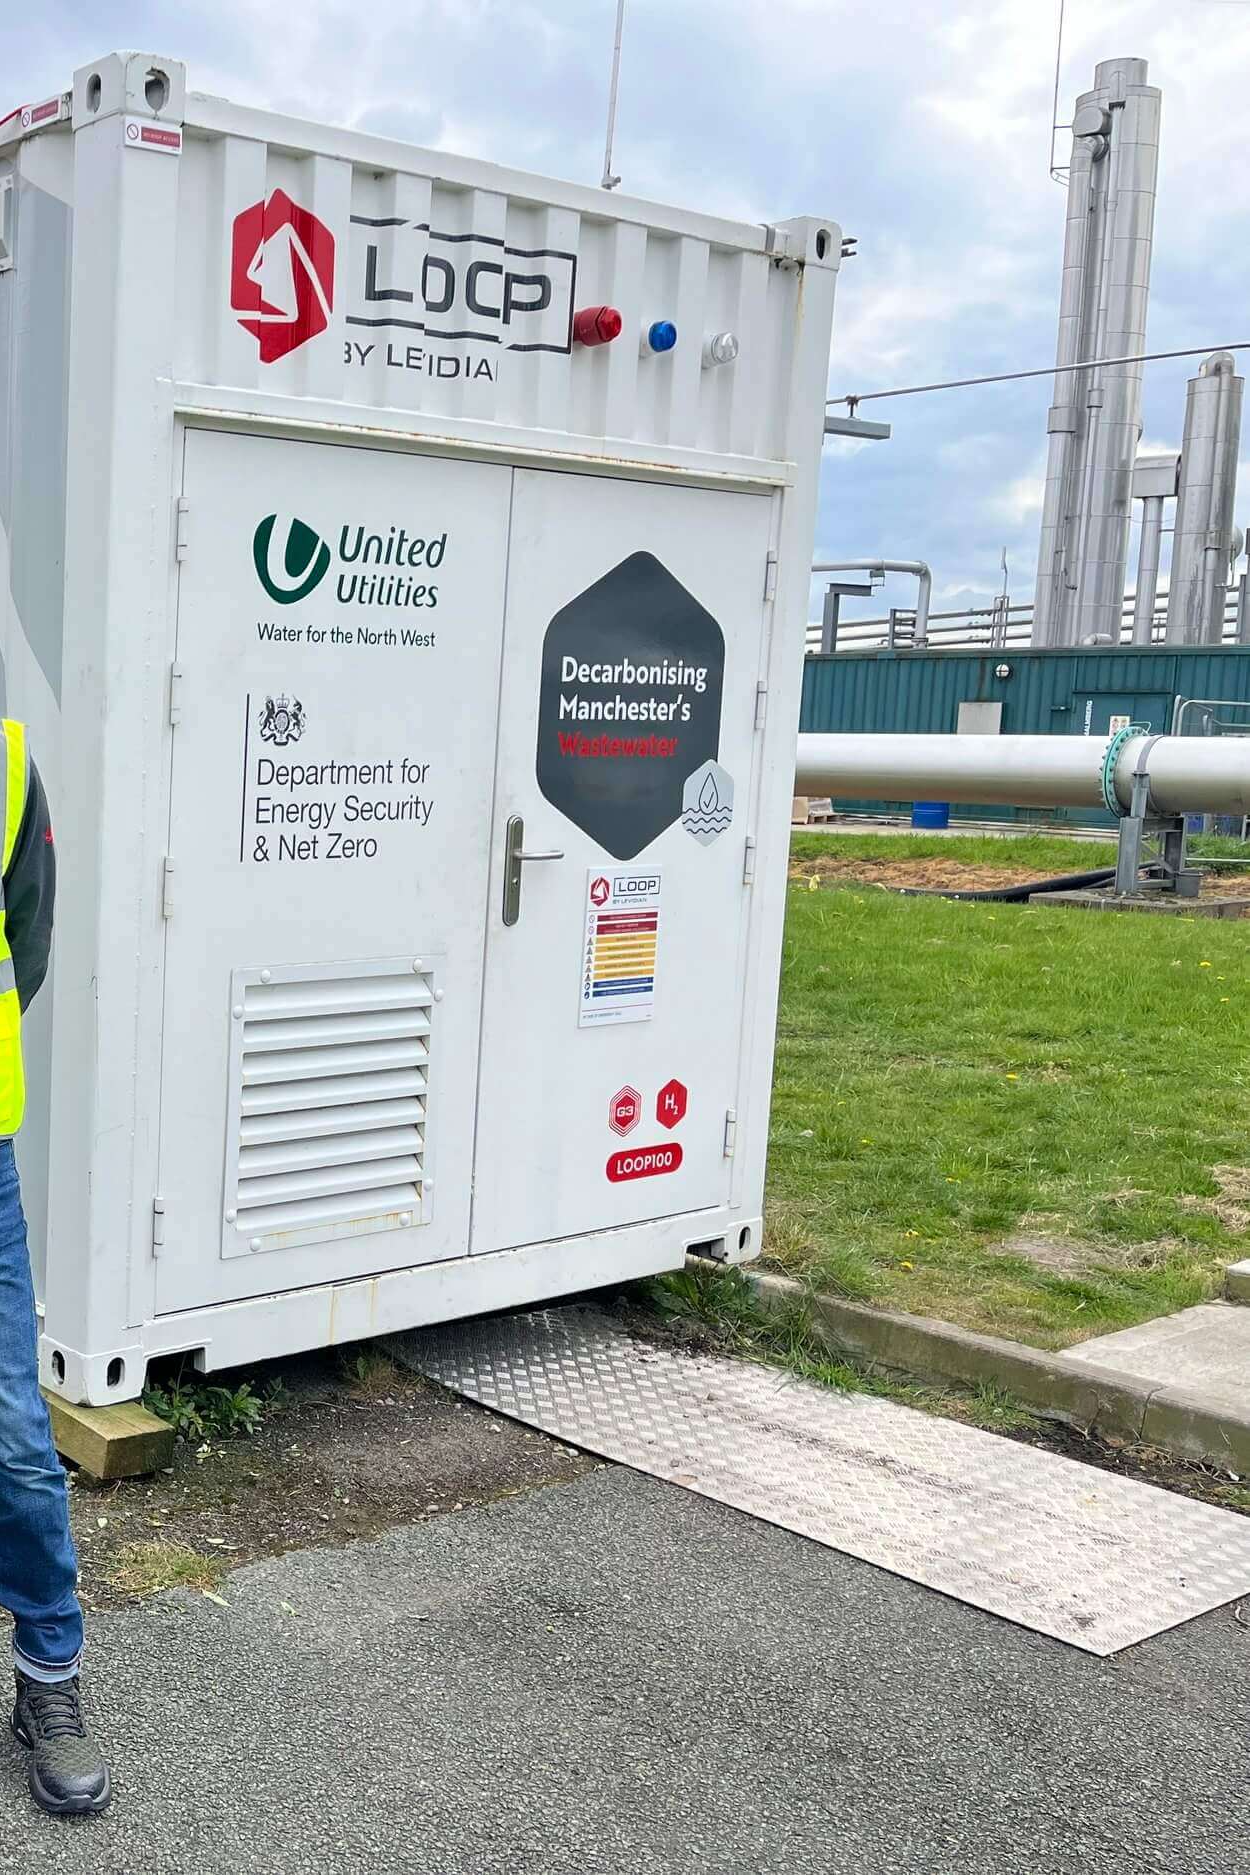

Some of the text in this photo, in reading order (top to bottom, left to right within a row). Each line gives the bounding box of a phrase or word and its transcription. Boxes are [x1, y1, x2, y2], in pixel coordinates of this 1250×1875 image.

[339, 525, 448, 568] United
[337, 574, 439, 608] Utilities
[257, 622, 436, 647] Water for the North West
[561, 655, 708, 692] Decarbonising
[559, 693, 691, 722] Manchester's
[558, 730, 679, 758] Wastewater
[257, 757, 431, 792] Department for
[256, 794, 434, 830] Energy Security
[253, 832, 378, 863] & Net Zero
[618, 880, 656, 893] LOOP
[616, 1105, 634, 1118] G3
[616, 1151, 673, 1175] LOOP100
